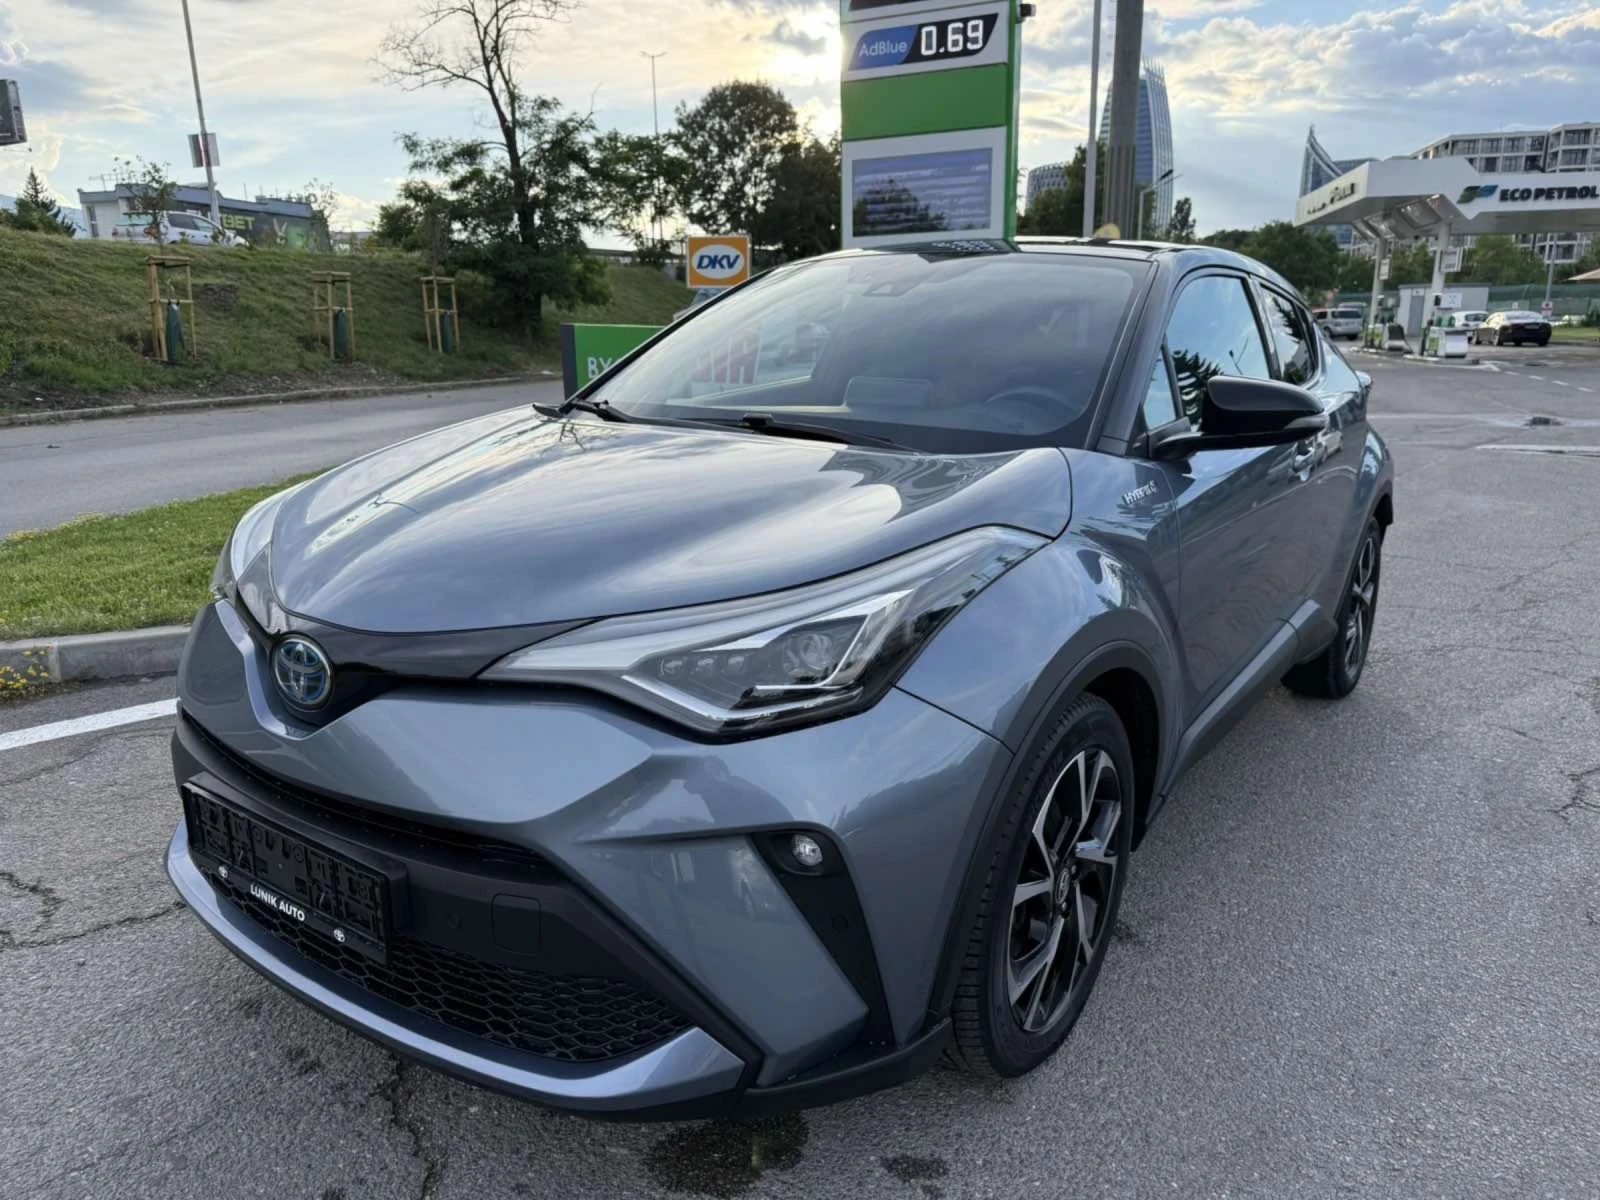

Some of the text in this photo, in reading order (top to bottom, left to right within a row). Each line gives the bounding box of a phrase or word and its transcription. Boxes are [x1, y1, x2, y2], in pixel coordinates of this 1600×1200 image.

[860, 19, 984, 57] AdBlue 0.69
[697, 254, 740, 270] DKV
[250, 883, 306, 921] LUNIK AUTO
